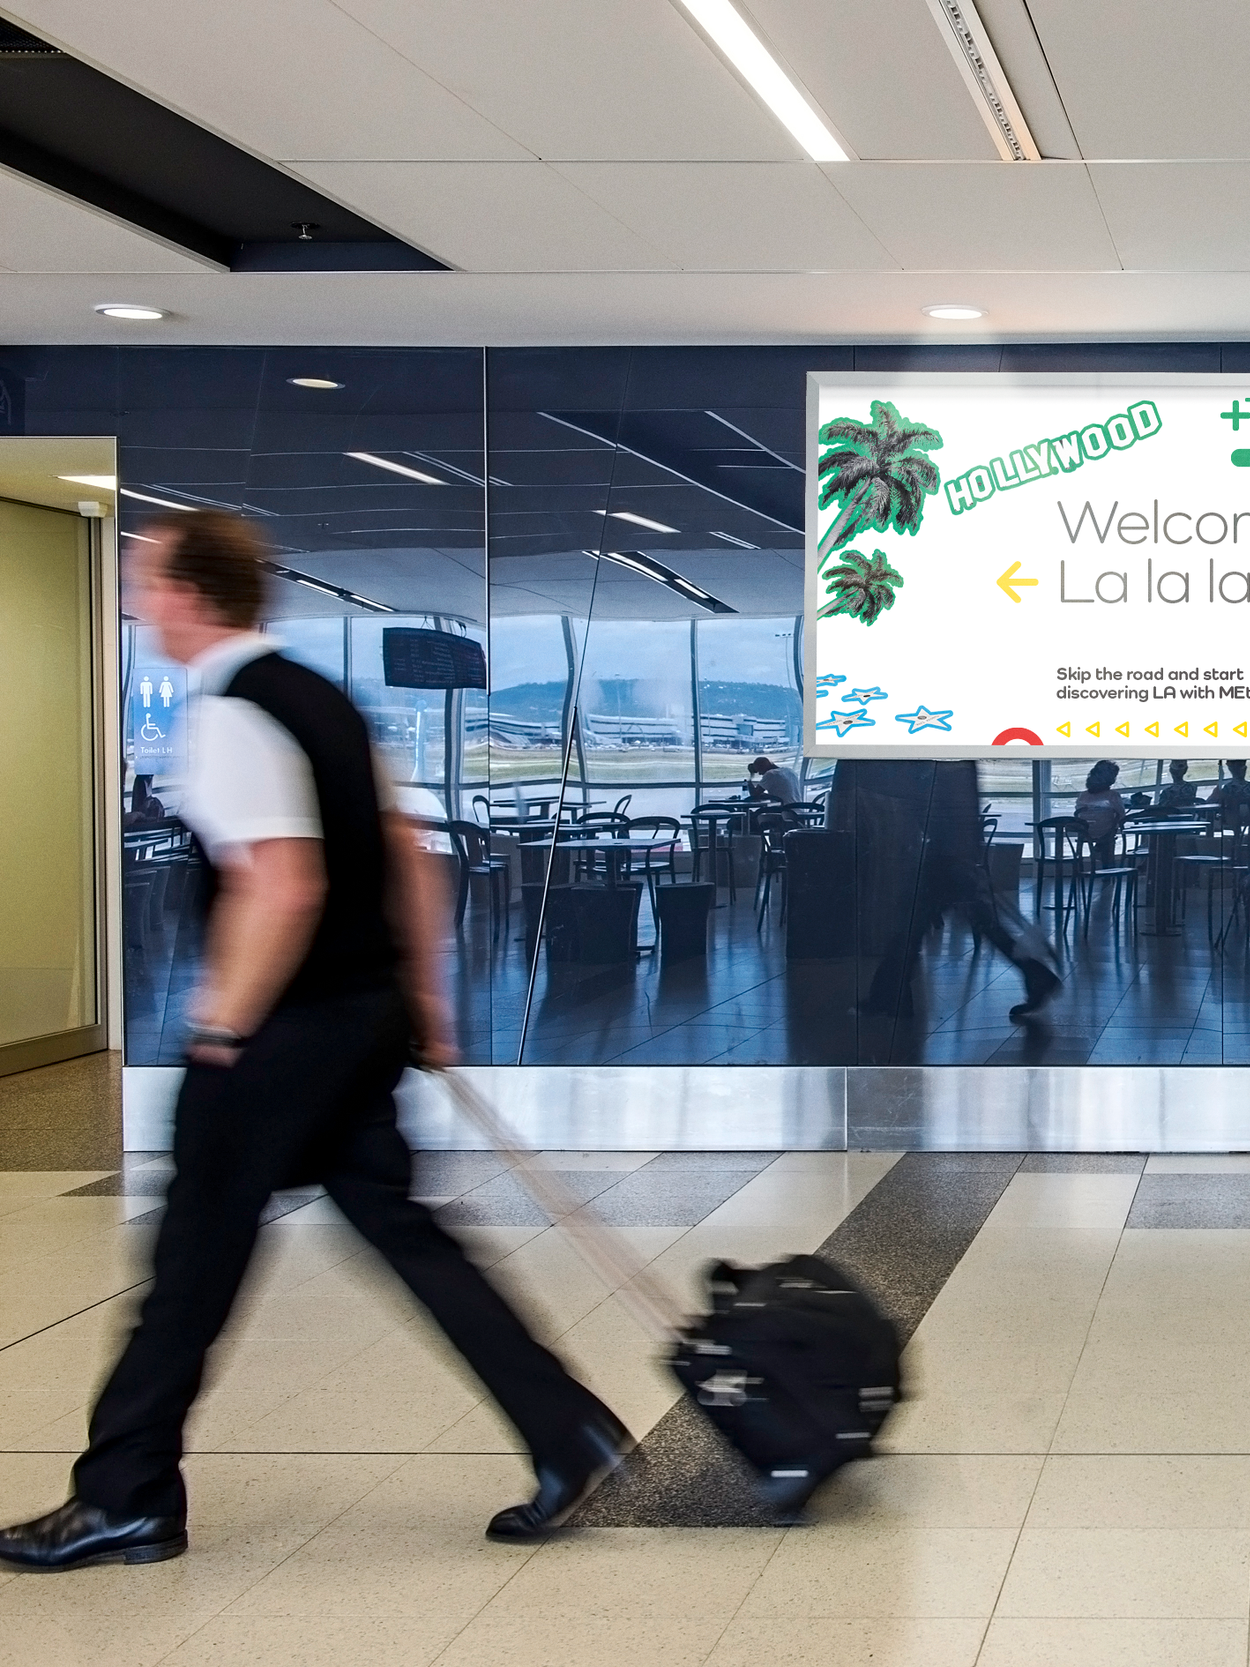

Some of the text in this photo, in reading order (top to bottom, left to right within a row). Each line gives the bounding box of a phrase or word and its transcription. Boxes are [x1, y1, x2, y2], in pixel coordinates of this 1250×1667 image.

[945, 401, 1162, 514] HOLLYWOOD
[1060, 559, 1128, 604] La
[1147, 558, 1190, 604] la
[1056, 667, 1245, 685] Skip the road and start
[1056, 685, 1149, 703] discovering
[1153, 686, 1176, 700] LA
[1180, 685, 1215, 700] with
